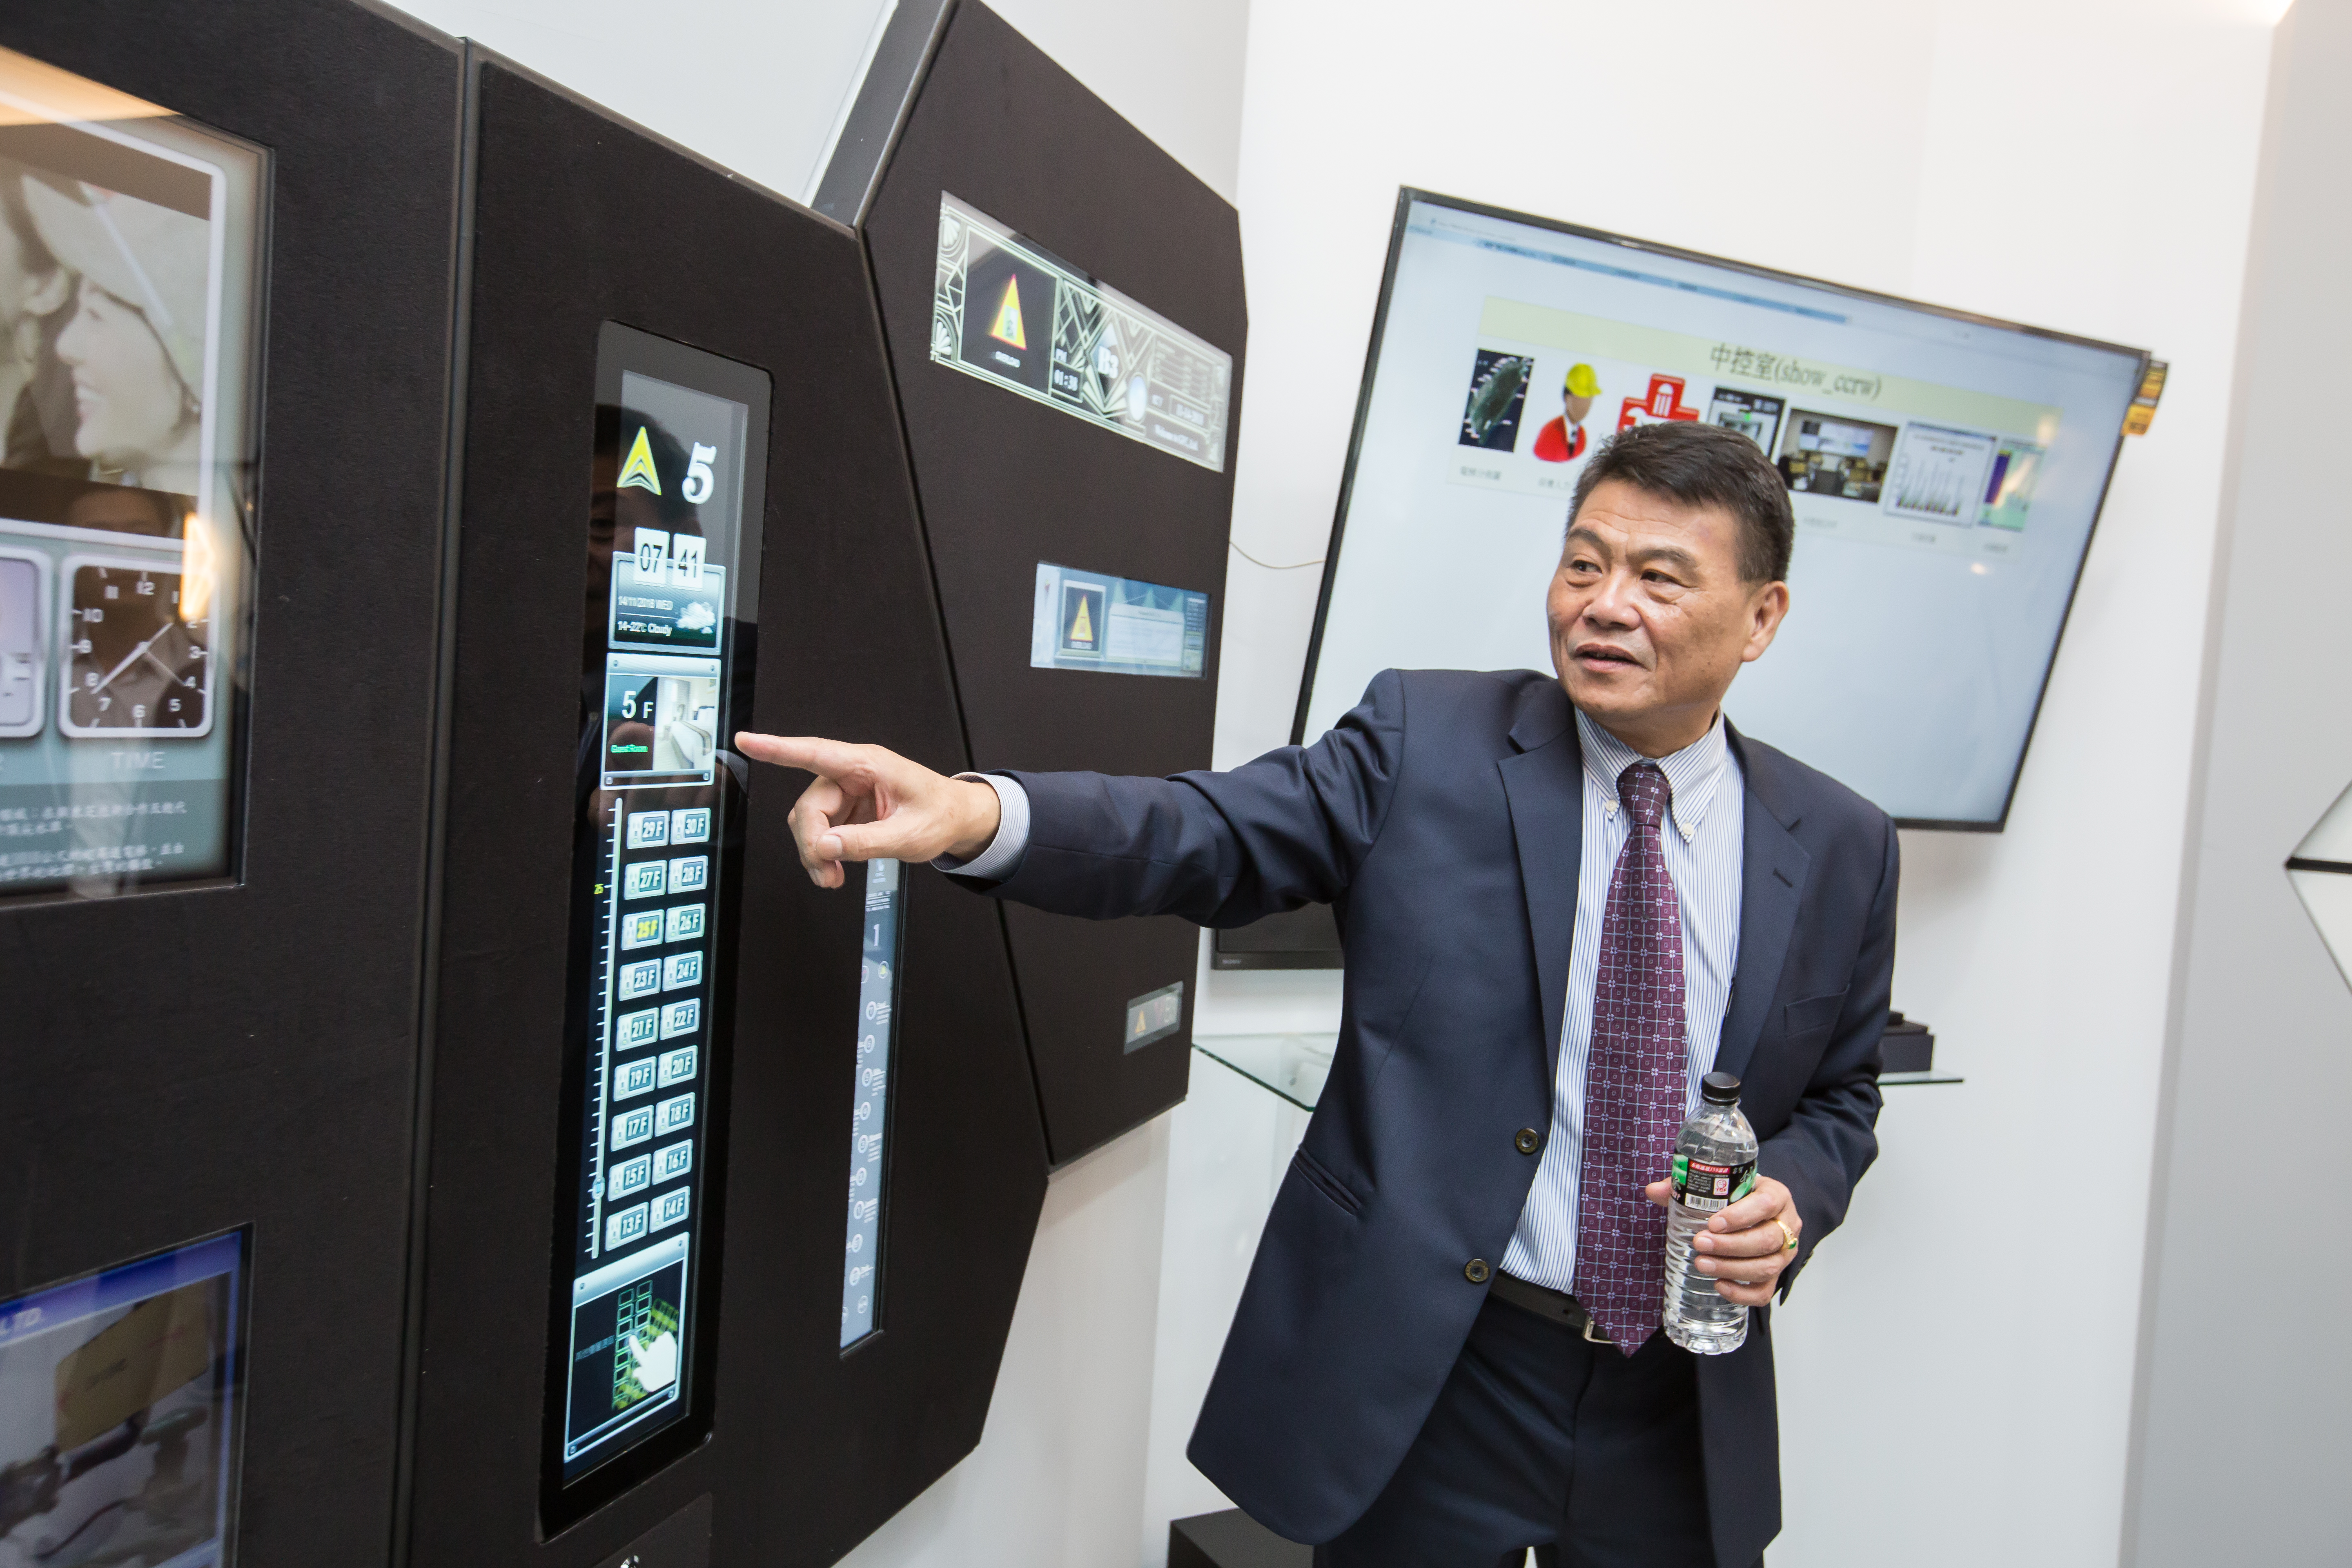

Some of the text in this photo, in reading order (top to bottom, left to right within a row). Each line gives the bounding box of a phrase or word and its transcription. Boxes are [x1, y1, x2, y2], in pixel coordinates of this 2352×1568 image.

[682, 442, 717, 504] 5
[639, 543, 697, 578] 07 41
[105, 585, 118, 599] 11
[136, 581, 155, 595] 12
[83, 608, 104, 622] 10
[78, 638, 92, 653] 9
[189, 646, 200, 659] 3
[85, 672, 100, 686] 8
[185, 676, 196, 689] 4
[100, 698, 111, 712] 7
[133, 705, 145, 718] 6
[169, 699, 181, 712] 5
[621, 690, 654, 719] 5 F
[111, 751, 165, 768] TIME
[643, 821, 663, 837] 29F
[639, 871, 661, 889] 27F
[637, 920, 658, 938] 25F
[679, 913, 699, 931] 26F
[873, 924, 880, 946] 1
[634, 969, 655, 988] 23F
[677, 961, 697, 979] 24F
[674, 1009, 694, 1027] 22F
[631, 1018, 653, 1038] 21F
[630, 1067, 650, 1087] 19F
[627, 1117, 647, 1136] 17F
[668, 1150, 686, 1169] 16F
[625, 1165, 645, 1185] 15F
[665, 1197, 684, 1217] 14F
[622, 1214, 642, 1234] 13F
